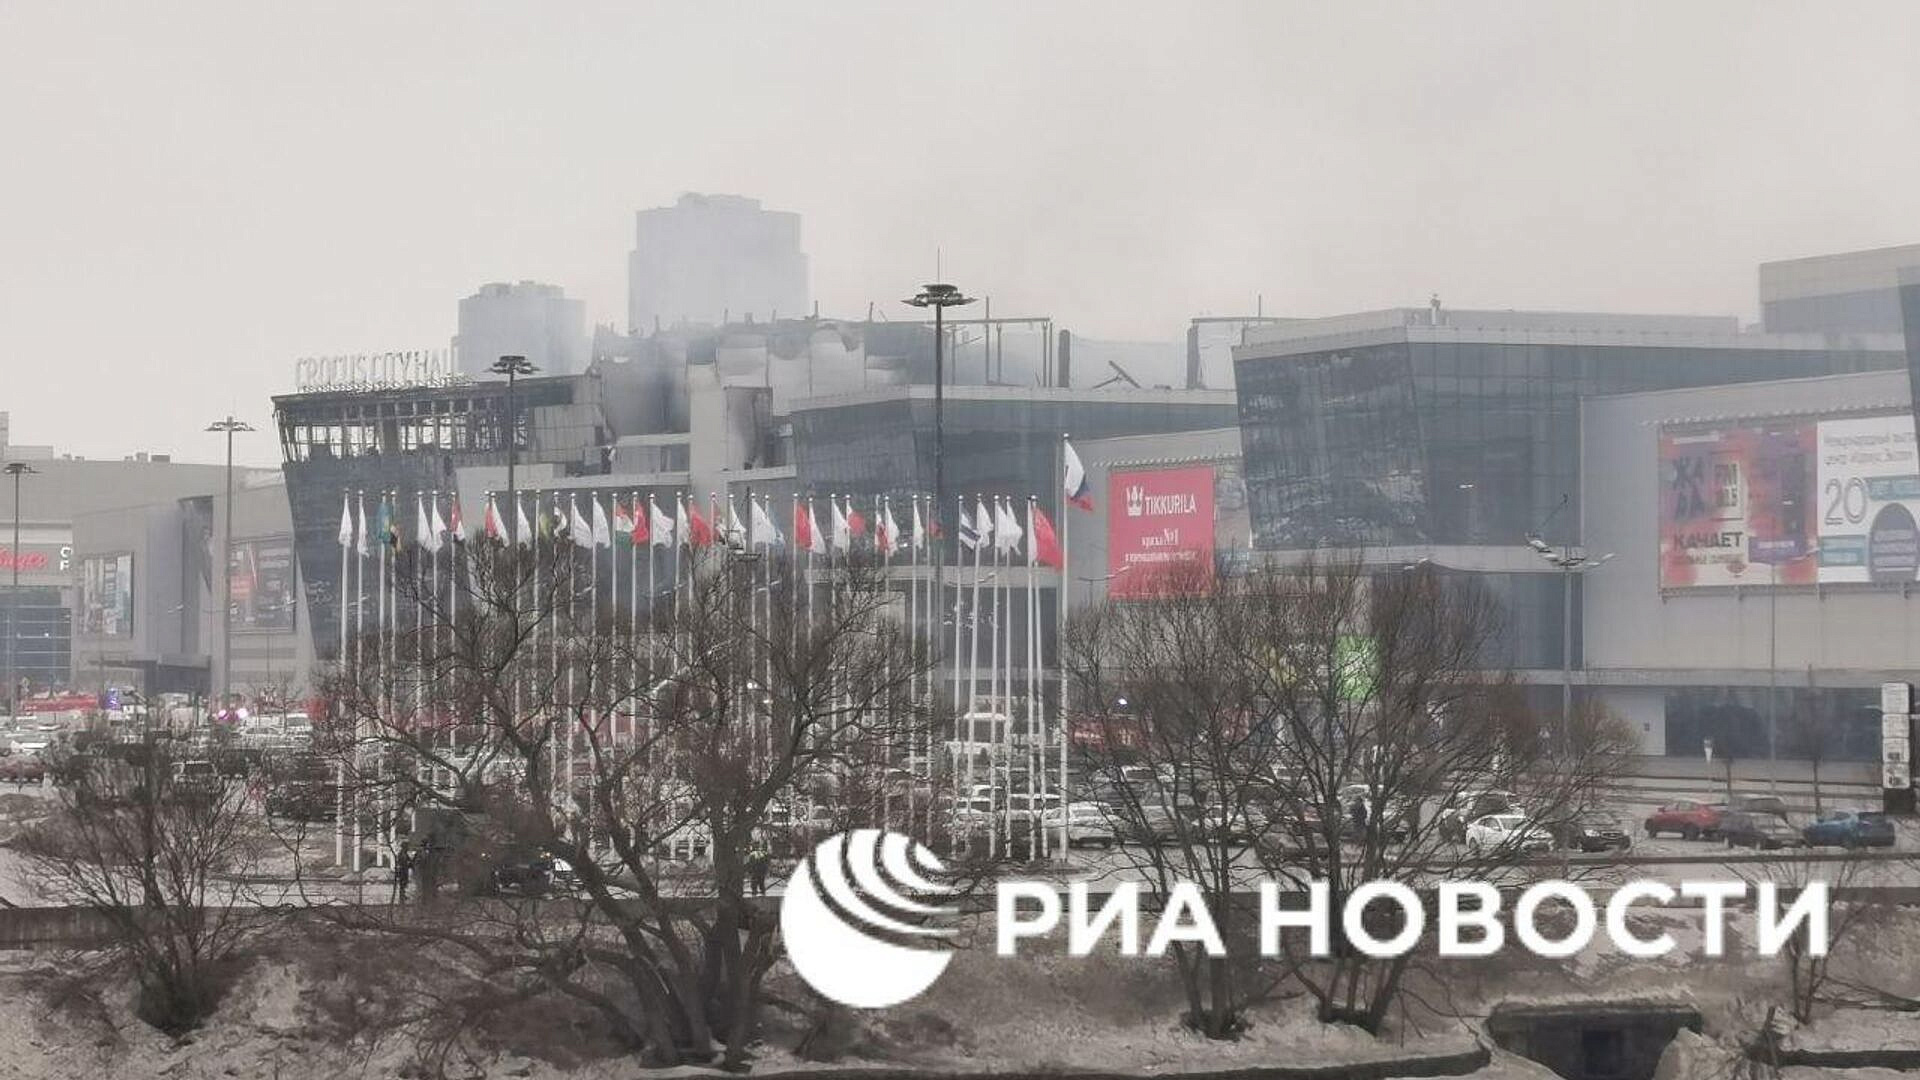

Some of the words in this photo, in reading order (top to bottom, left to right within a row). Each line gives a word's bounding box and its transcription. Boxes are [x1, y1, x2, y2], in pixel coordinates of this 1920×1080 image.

[1144, 493, 1197, 516] TIKKURILA
[1825, 477, 1867, 526] 20
[1674, 531, 1743, 550] КАЧАЕТ
